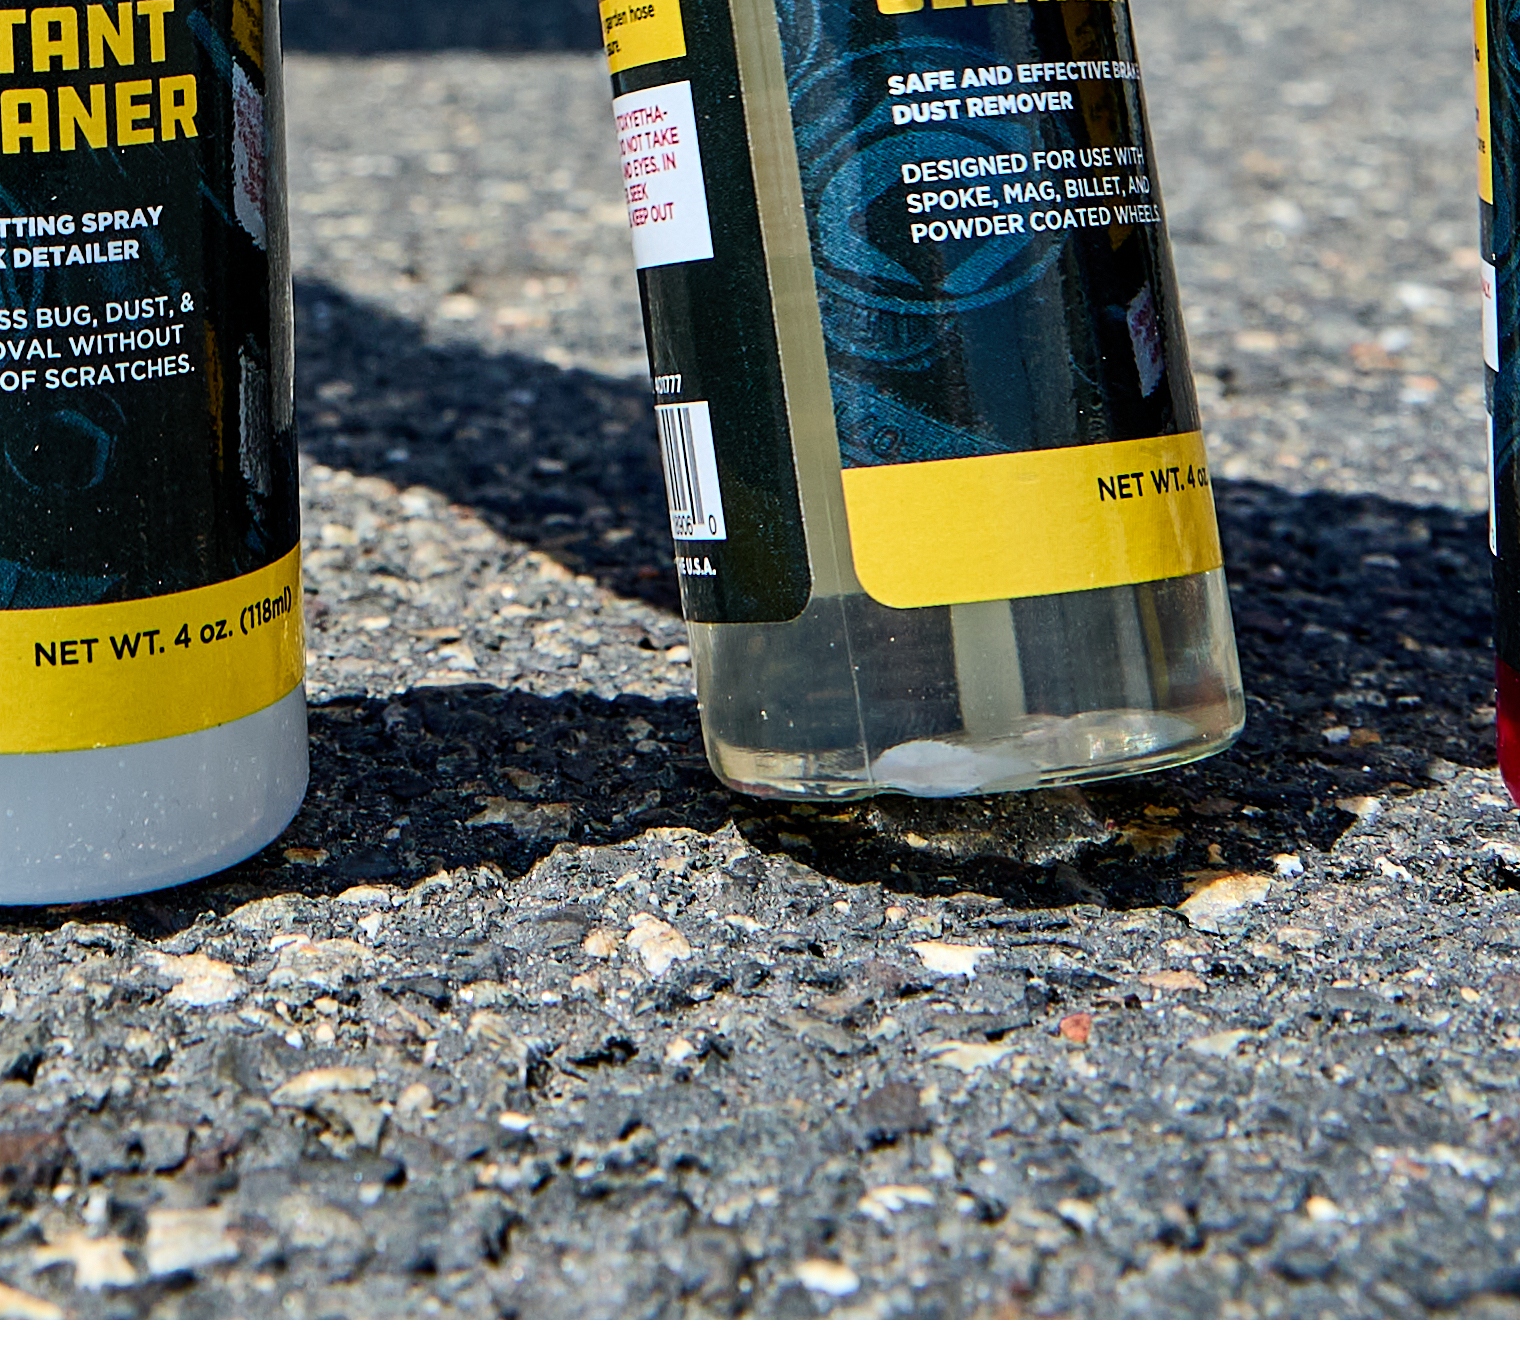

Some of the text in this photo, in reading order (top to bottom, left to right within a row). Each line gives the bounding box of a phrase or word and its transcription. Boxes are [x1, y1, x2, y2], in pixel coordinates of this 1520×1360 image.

[629, 4, 655, 23] hose
[887, 70, 957, 96] SAFE
[960, 65, 1013, 89] AND
[1017, 61, 1110, 84] EFFECTIVE
[892, 91, 1074, 125] DUST REMOVER
[645, 126, 679, 149] TAKE
[662, 152, 676, 170] IN
[901, 146, 1144, 184] DESIGNED FOR USE WITH
[906, 175, 1150, 214] SPOKE, MAG, BILLET, AND
[81, 206, 163, 233] SPRAY
[650, 202, 674, 222] OUT
[910, 213, 1024, 243] POWDER
[1030, 206, 1111, 231] COATED
[14, 240, 140, 268] DETAILER
[36, 305, 98, 329] BUG,
[105, 296, 175, 324] DUST,
[180, 292, 194, 312] &
[68, 324, 184, 357] WITHOUT
[0, 370, 36, 391] OF
[45, 354, 195, 389] SCRATCHES.
[1097, 465, 1209, 501] NET WT. 4 oz
[685, 556, 717, 576] U.S.A.
[35, 586, 292, 667] NET WT. 4 oz. (118ml)
